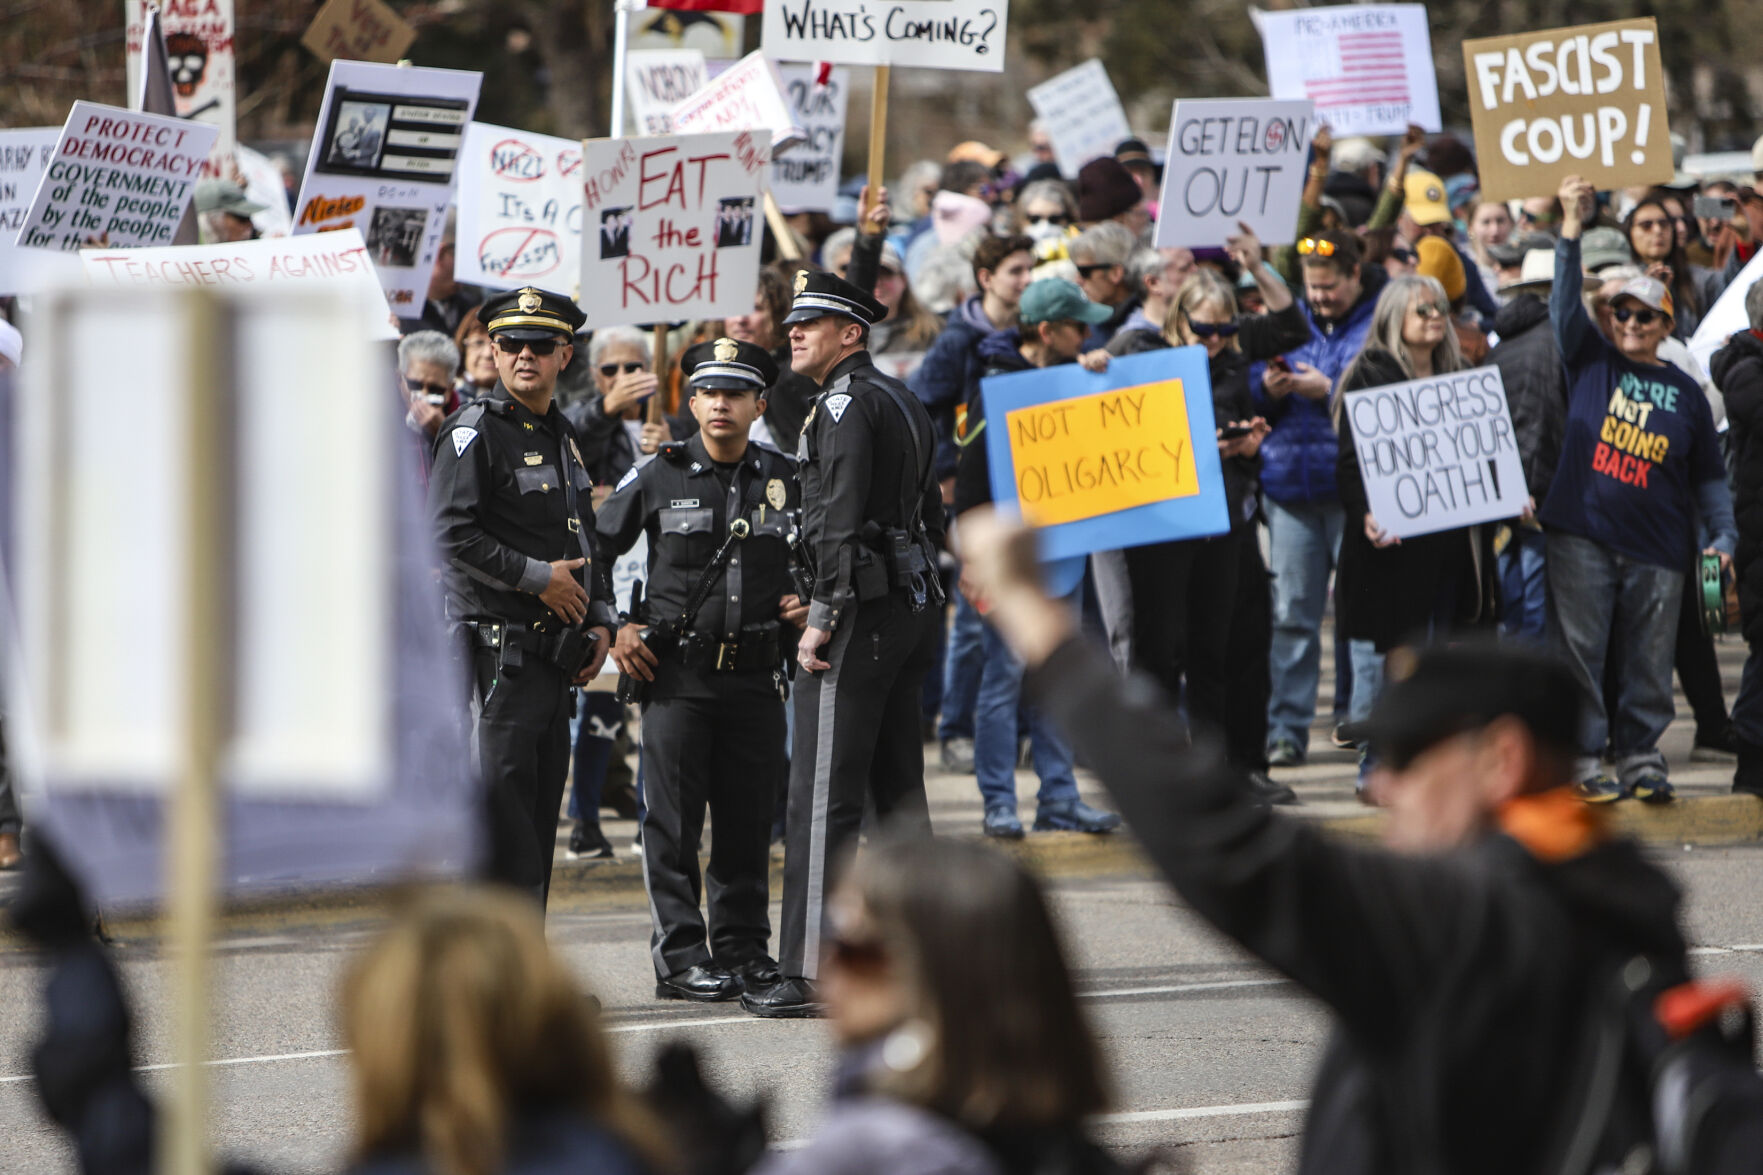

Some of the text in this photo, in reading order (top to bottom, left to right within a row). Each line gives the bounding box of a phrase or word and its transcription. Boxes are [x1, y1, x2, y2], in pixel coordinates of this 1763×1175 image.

[142, 0, 220, 18] AGA
[782, 0, 998, 54] WHAT'S COMING?
[1473, 28, 1655, 110] FASCIST
[84, 114, 189, 148] PROTECT
[1178, 115, 1306, 156] GET ELON
[1500, 102, 1652, 167] COUP!
[49, 160, 191, 200] GOVERNMENT
[51, 183, 76, 202] of
[80, 184, 111, 209] the
[638, 145, 731, 211] EAT
[1184, 165, 1283, 218] OUT
[25, 223, 56, 247] for
[41, 202, 66, 228] by
[70, 206, 102, 231] the
[651, 217, 703, 248] the
[92, 247, 371, 286] TEACHERS AGAINST
[617, 250, 719, 309] RICH
[1352, 371, 1503, 438] CONGRESS
[1607, 386, 1653, 430] NOT
[1618, 371, 1680, 413] WE'RE
[1016, 391, 1146, 447] NOT MY
[1600, 415, 1669, 465] GOING
[1019, 438, 1184, 503] OLIGARCY
[1359, 415, 1515, 480] HONOR YOUR
[1591, 441, 1653, 489] BACK
[1394, 457, 1503, 519] OATH!
